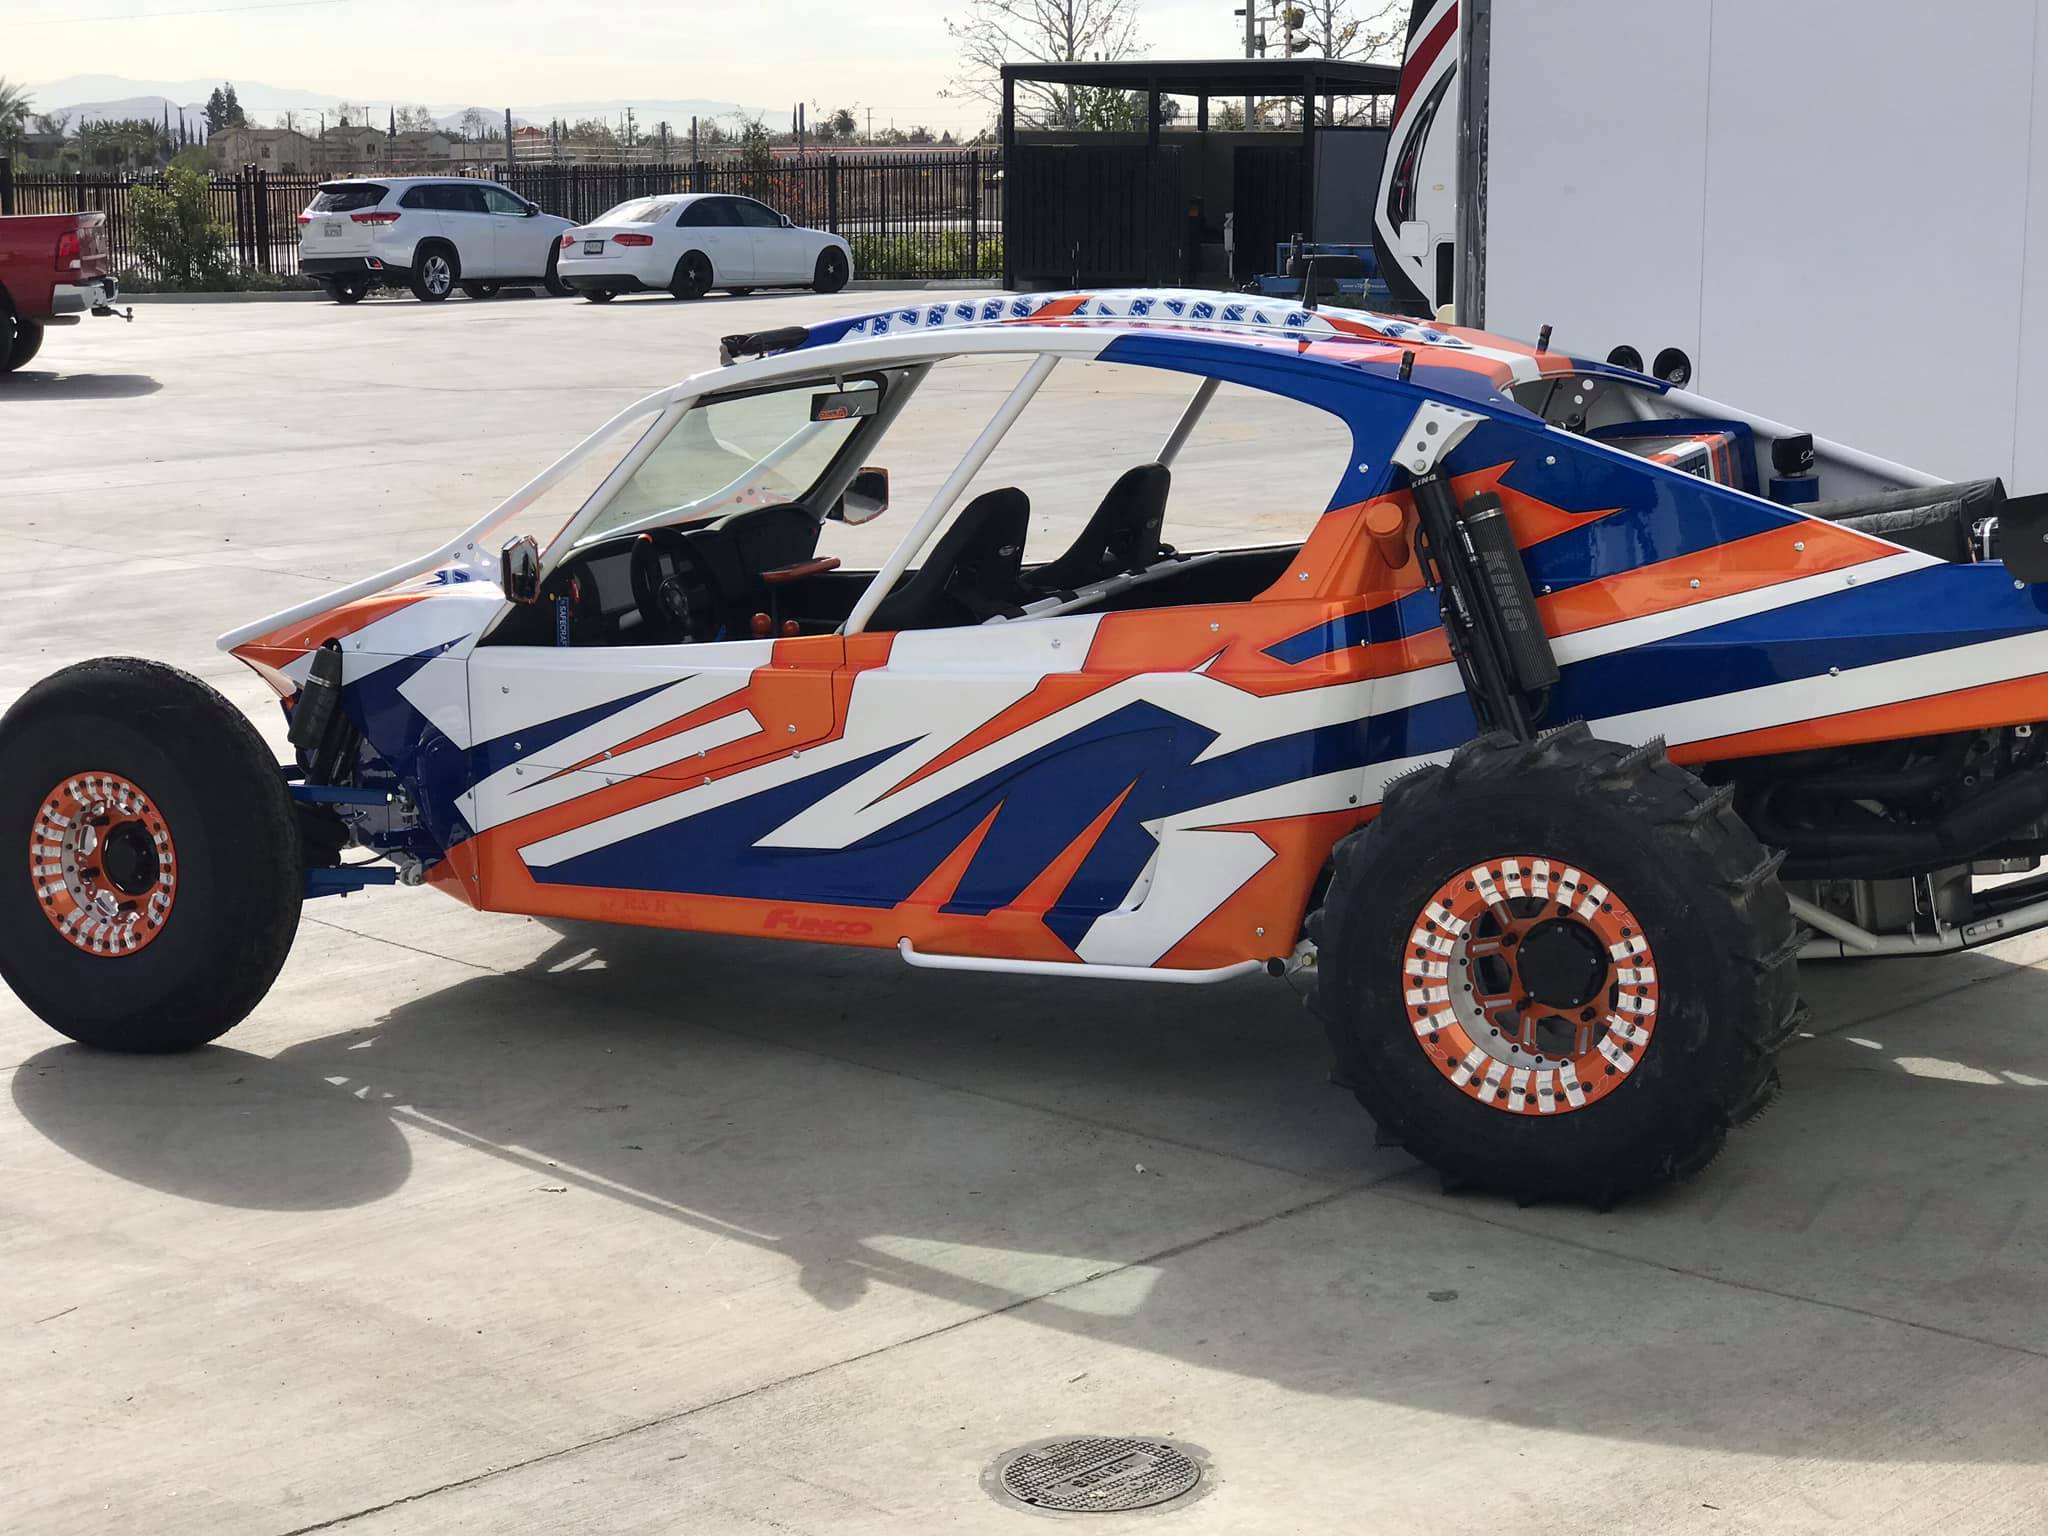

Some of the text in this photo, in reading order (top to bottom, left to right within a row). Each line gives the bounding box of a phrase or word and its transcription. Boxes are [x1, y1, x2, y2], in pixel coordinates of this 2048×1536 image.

[1411, 473, 1437, 489] KING
[1482, 550, 1529, 632] KING
[1071, 1462, 1134, 1488] SEWER
